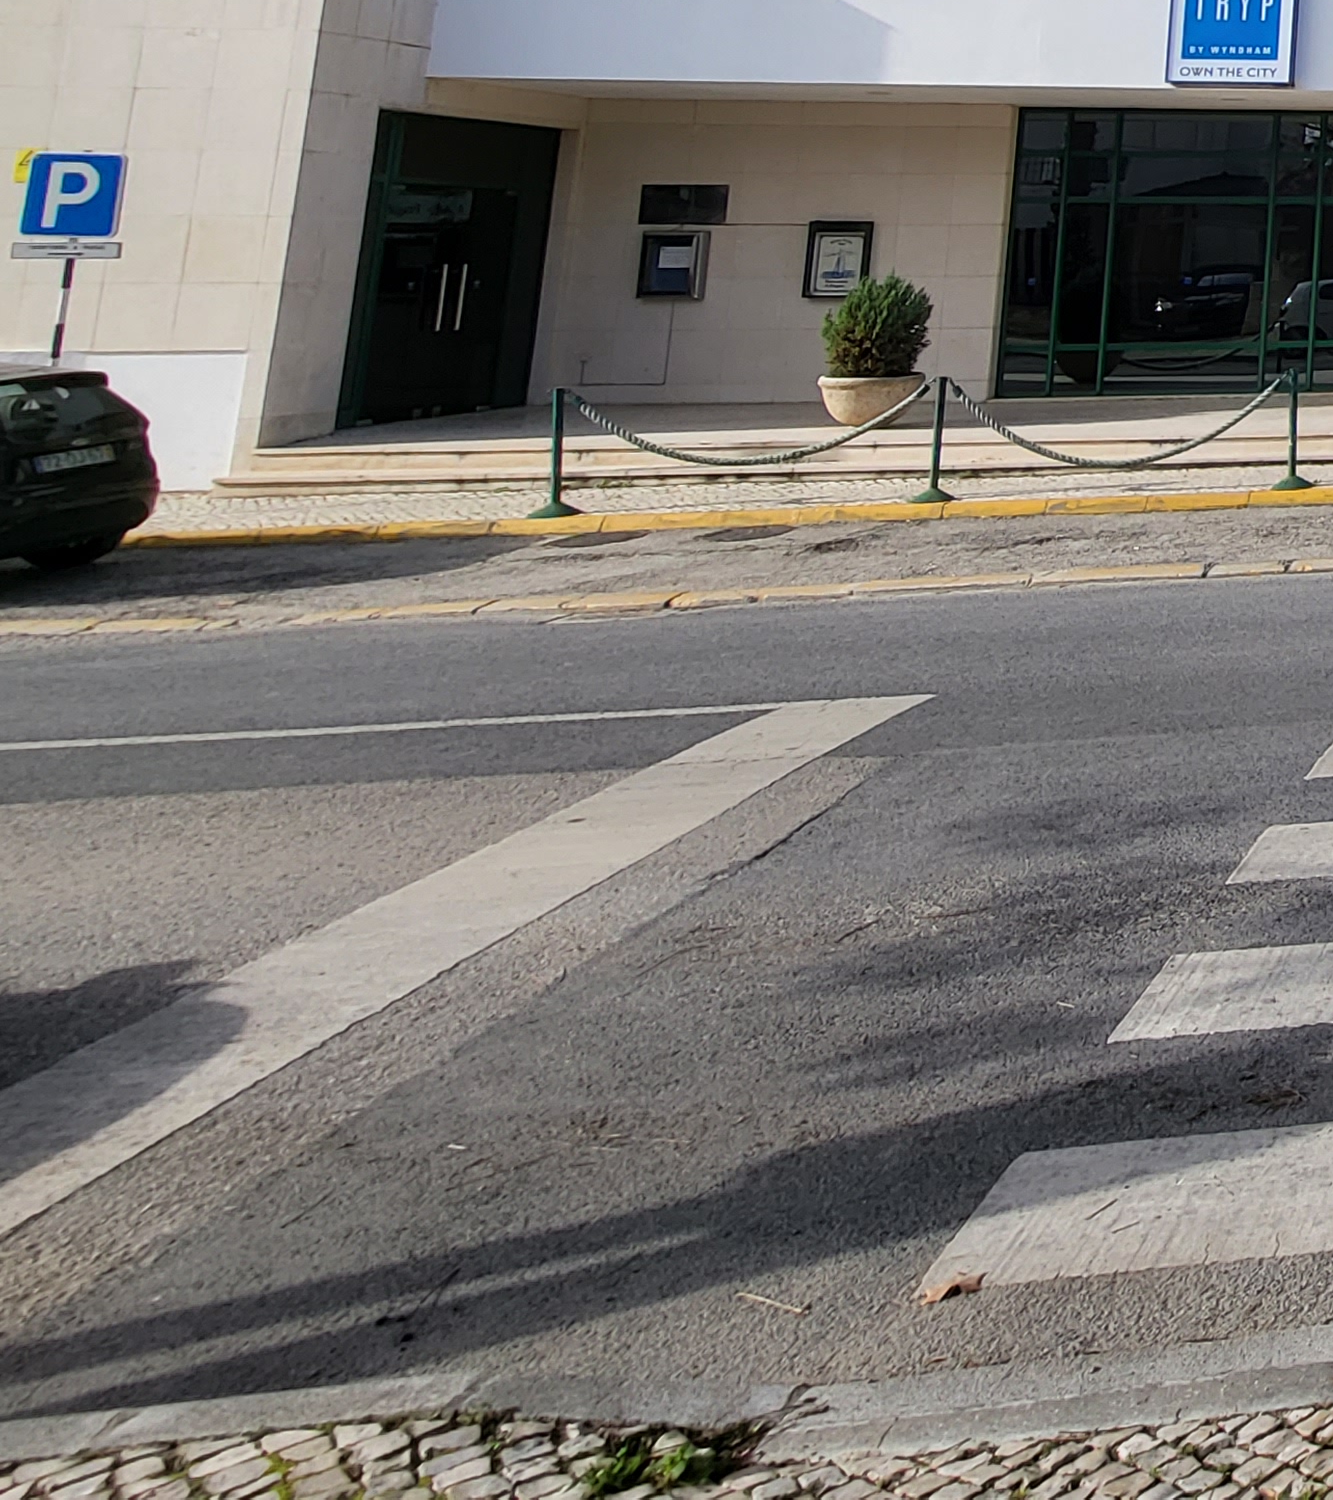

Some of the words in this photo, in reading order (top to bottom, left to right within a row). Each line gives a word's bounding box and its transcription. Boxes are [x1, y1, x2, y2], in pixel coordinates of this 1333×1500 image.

[1189, 46, 1204, 54] BY
[1210, 46, 1271, 55] WYNDHAM
[1179, 66, 1213, 77] OWN
[1216, 67, 1243, 77] THE
[1246, 67, 1278, 78] CITY
[40, 161, 100, 228] P
